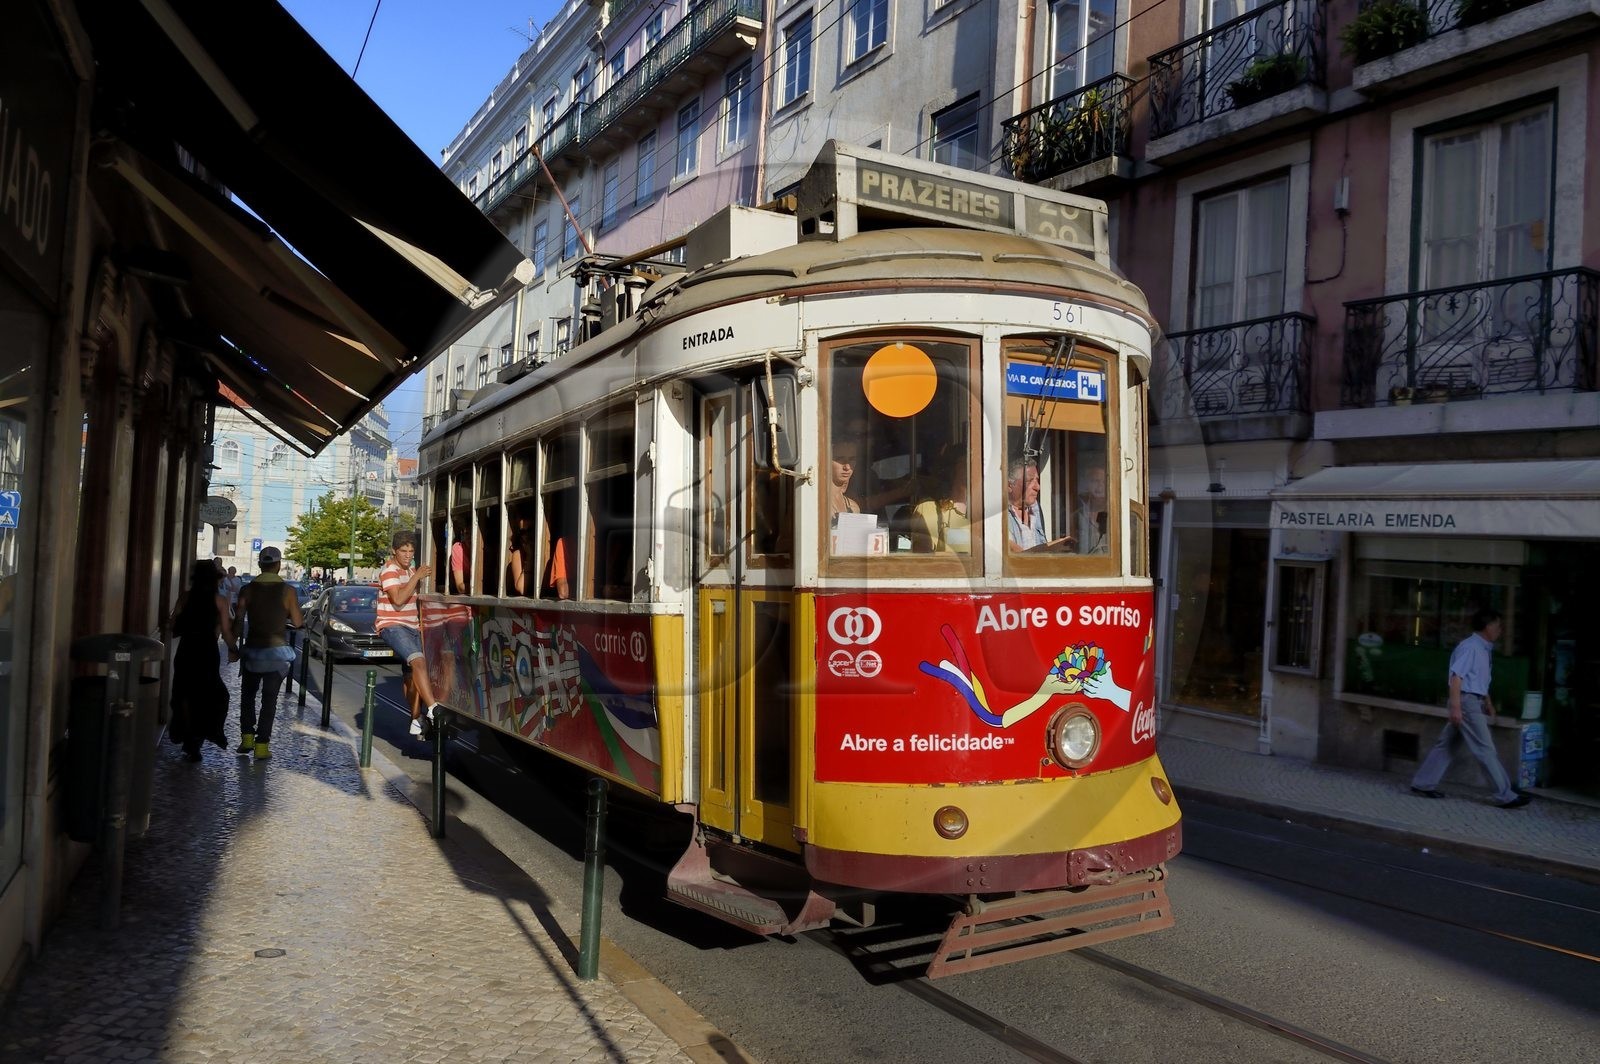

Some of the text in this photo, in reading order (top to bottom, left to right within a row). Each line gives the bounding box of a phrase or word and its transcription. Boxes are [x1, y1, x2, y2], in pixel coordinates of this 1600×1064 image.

[0, 97, 53, 256] IADO
[862, 168, 1000, 219] PRAZERES
[1053, 302, 1083, 325] 561
[682, 326, 734, 350] ENTRADA
[1007, 373, 1020, 383] VIA
[1020, 375, 1029, 384] R.
[1279, 511, 1456, 528] PASTELARIA EMENDA
[975, 600, 1140, 634] Abre o sorriso
[594, 627, 627, 656] carris
[840, 733, 887, 751] Abre
[892, 737, 904, 751] a
